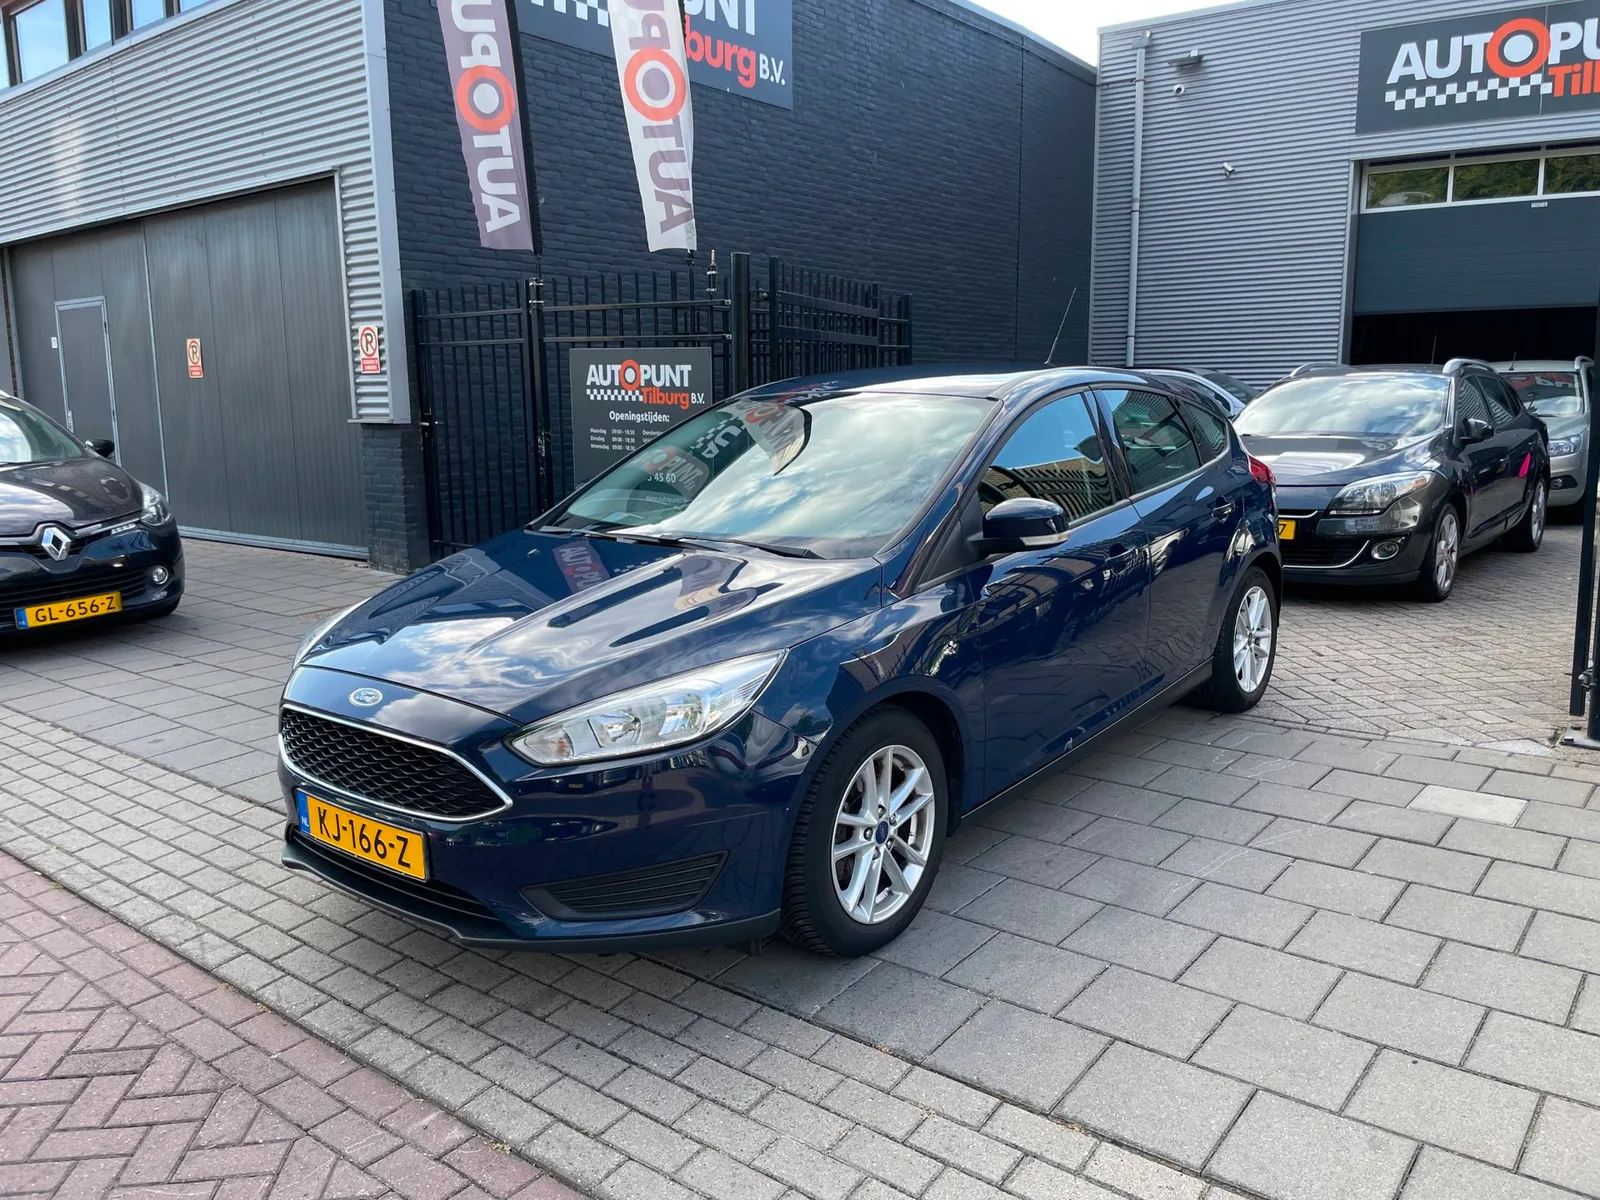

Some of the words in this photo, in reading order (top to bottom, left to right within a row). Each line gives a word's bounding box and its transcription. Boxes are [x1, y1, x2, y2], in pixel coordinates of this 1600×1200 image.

[684, 14, 757, 89] burg
[759, 53, 786, 86] B.V.
[586, 359, 692, 391] AUTOPUNT
[641, 386, 690, 410] Tilburg
[690, 392, 706, 405] B.V.
[609, 410, 670, 424] Openingstijden:
[654, 472, 664, 482] 45
[666, 473, 676, 484] 60
[35, 595, 117, 623] GL-656-Z
[317, 805, 412, 868] KJ-166-Z
